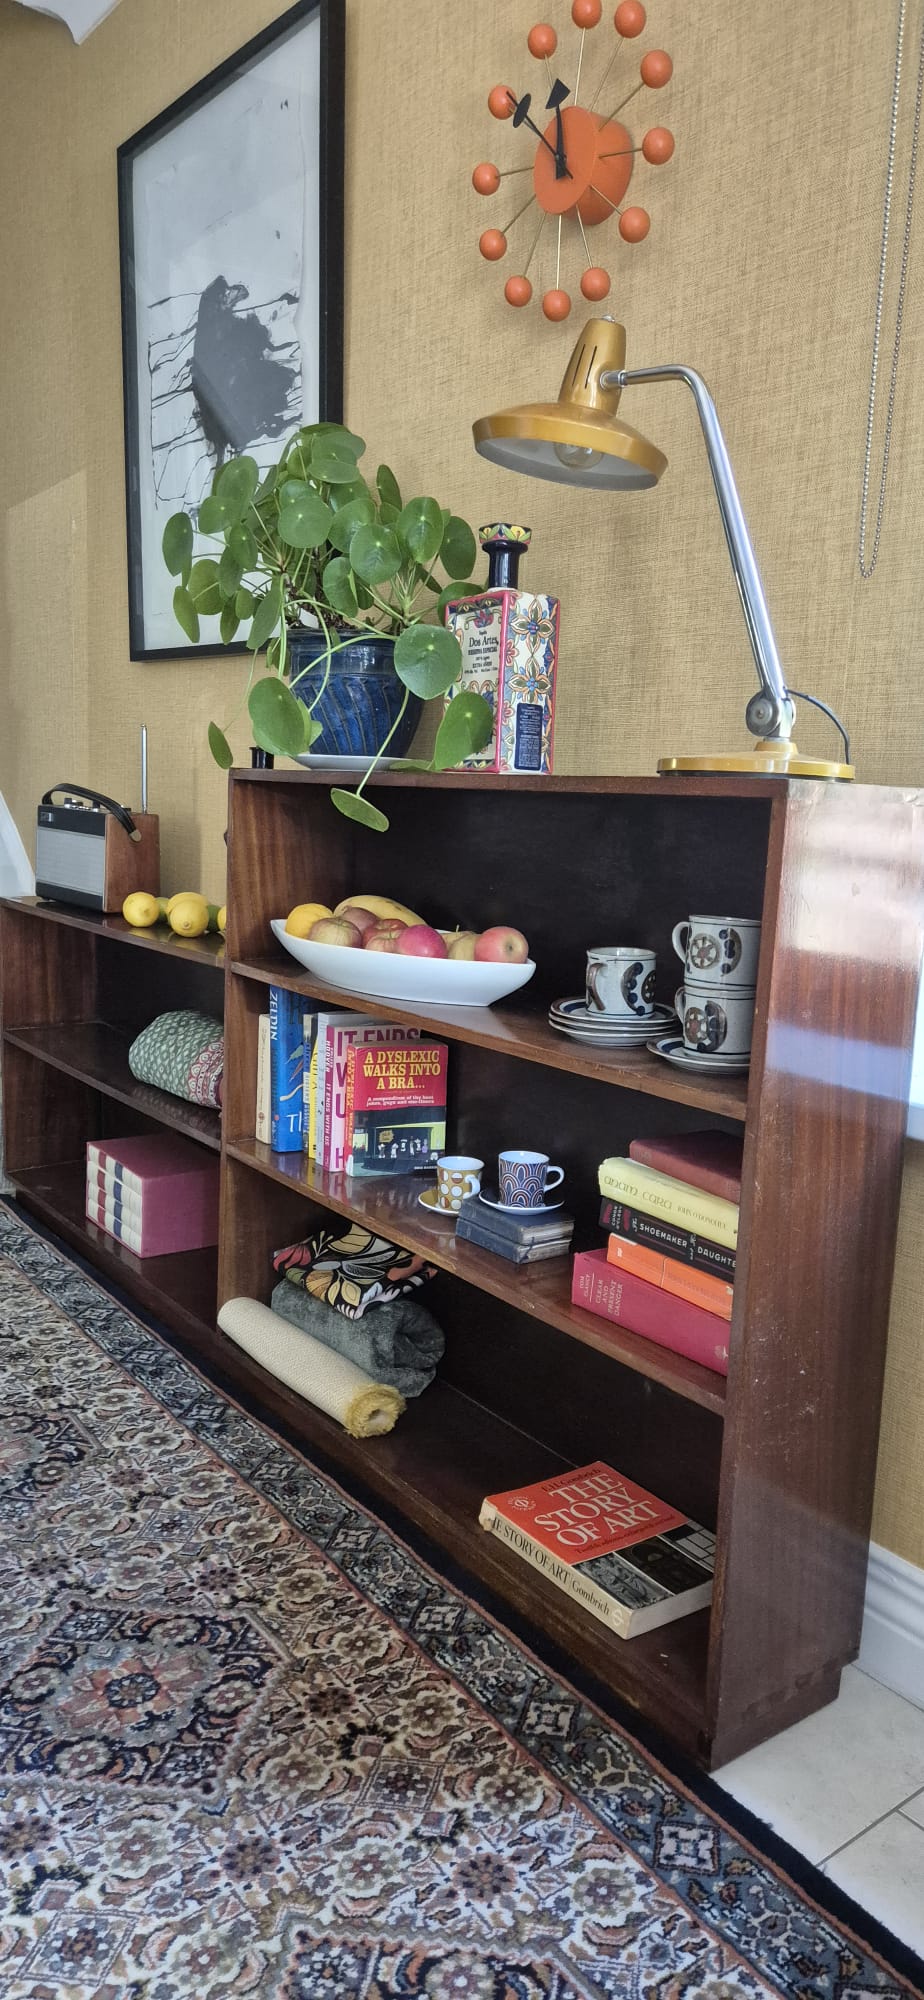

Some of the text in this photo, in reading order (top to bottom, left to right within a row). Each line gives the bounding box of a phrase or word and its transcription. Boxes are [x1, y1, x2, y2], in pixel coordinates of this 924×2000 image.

[469, 637, 481, 647] Dos
[269, 992, 278, 1040] ZELDIN
[363, 1063, 441, 1077] WALKS INTO
[365, 1050, 440, 1064] A DYSLEXIC
[325, 1083, 331, 1091] IT
[376, 1076, 425, 1090] A BRA...
[324, 1135, 330, 1146] US
[639, 1223, 688, 1249] SHOEMAKER
[697, 1246, 737, 1268] DAUGHTE
[614, 1282, 623, 1317] DANGER
[549, 1473, 623, 1505] THE
[534, 1487, 636, 1532] STORY
[556, 1521, 602, 1546] OF
[602, 1500, 662, 1535] ART
[504, 1525, 535, 1556] STORY
[535, 1549, 549, 1569] OF
[548, 1564, 571, 1585] ART
[572, 1579, 611, 1616] Gombrich
